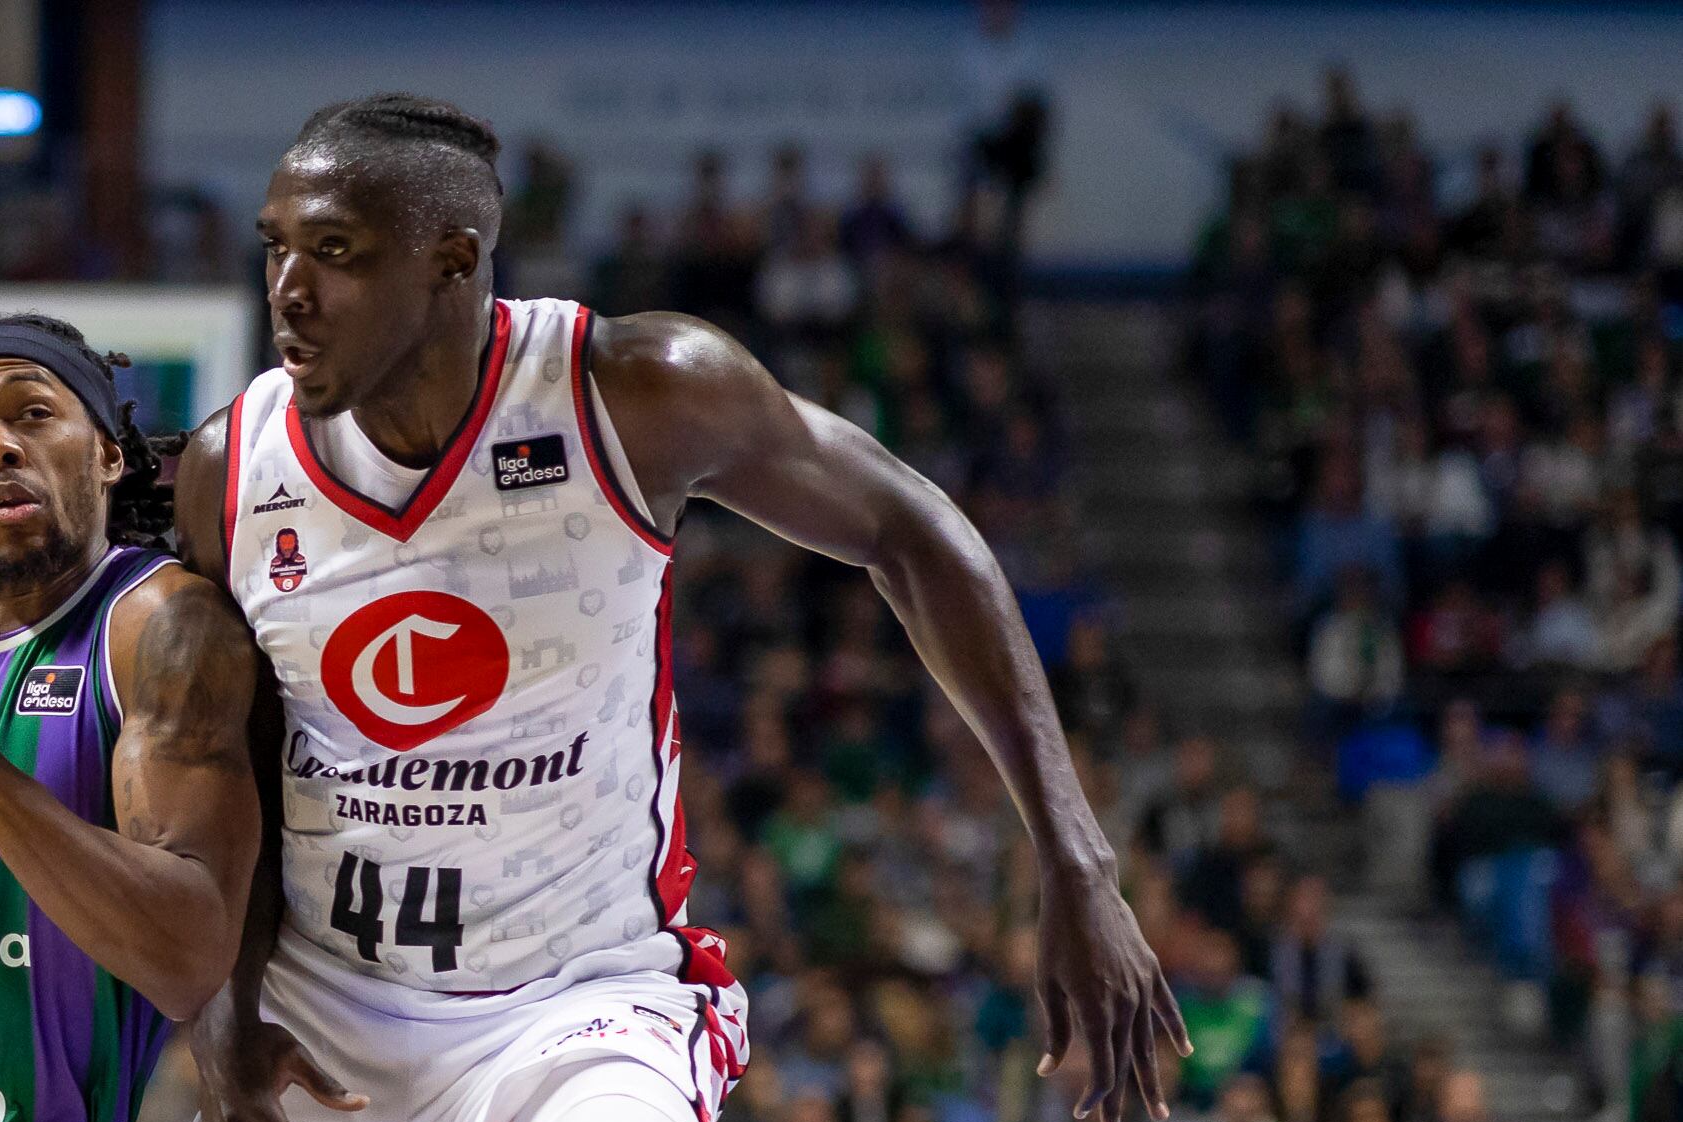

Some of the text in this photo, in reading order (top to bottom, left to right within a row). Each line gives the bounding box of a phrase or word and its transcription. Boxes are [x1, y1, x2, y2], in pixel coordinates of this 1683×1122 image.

[498, 457, 528, 472] liga
[500, 466, 565, 485] endesa
[253, 498, 306, 514] MERCURY
[26, 680, 50, 696] liga
[23, 695, 74, 709] endesa
[336, 794, 487, 827] ZARAGOZA
[331, 850, 464, 973] 44
